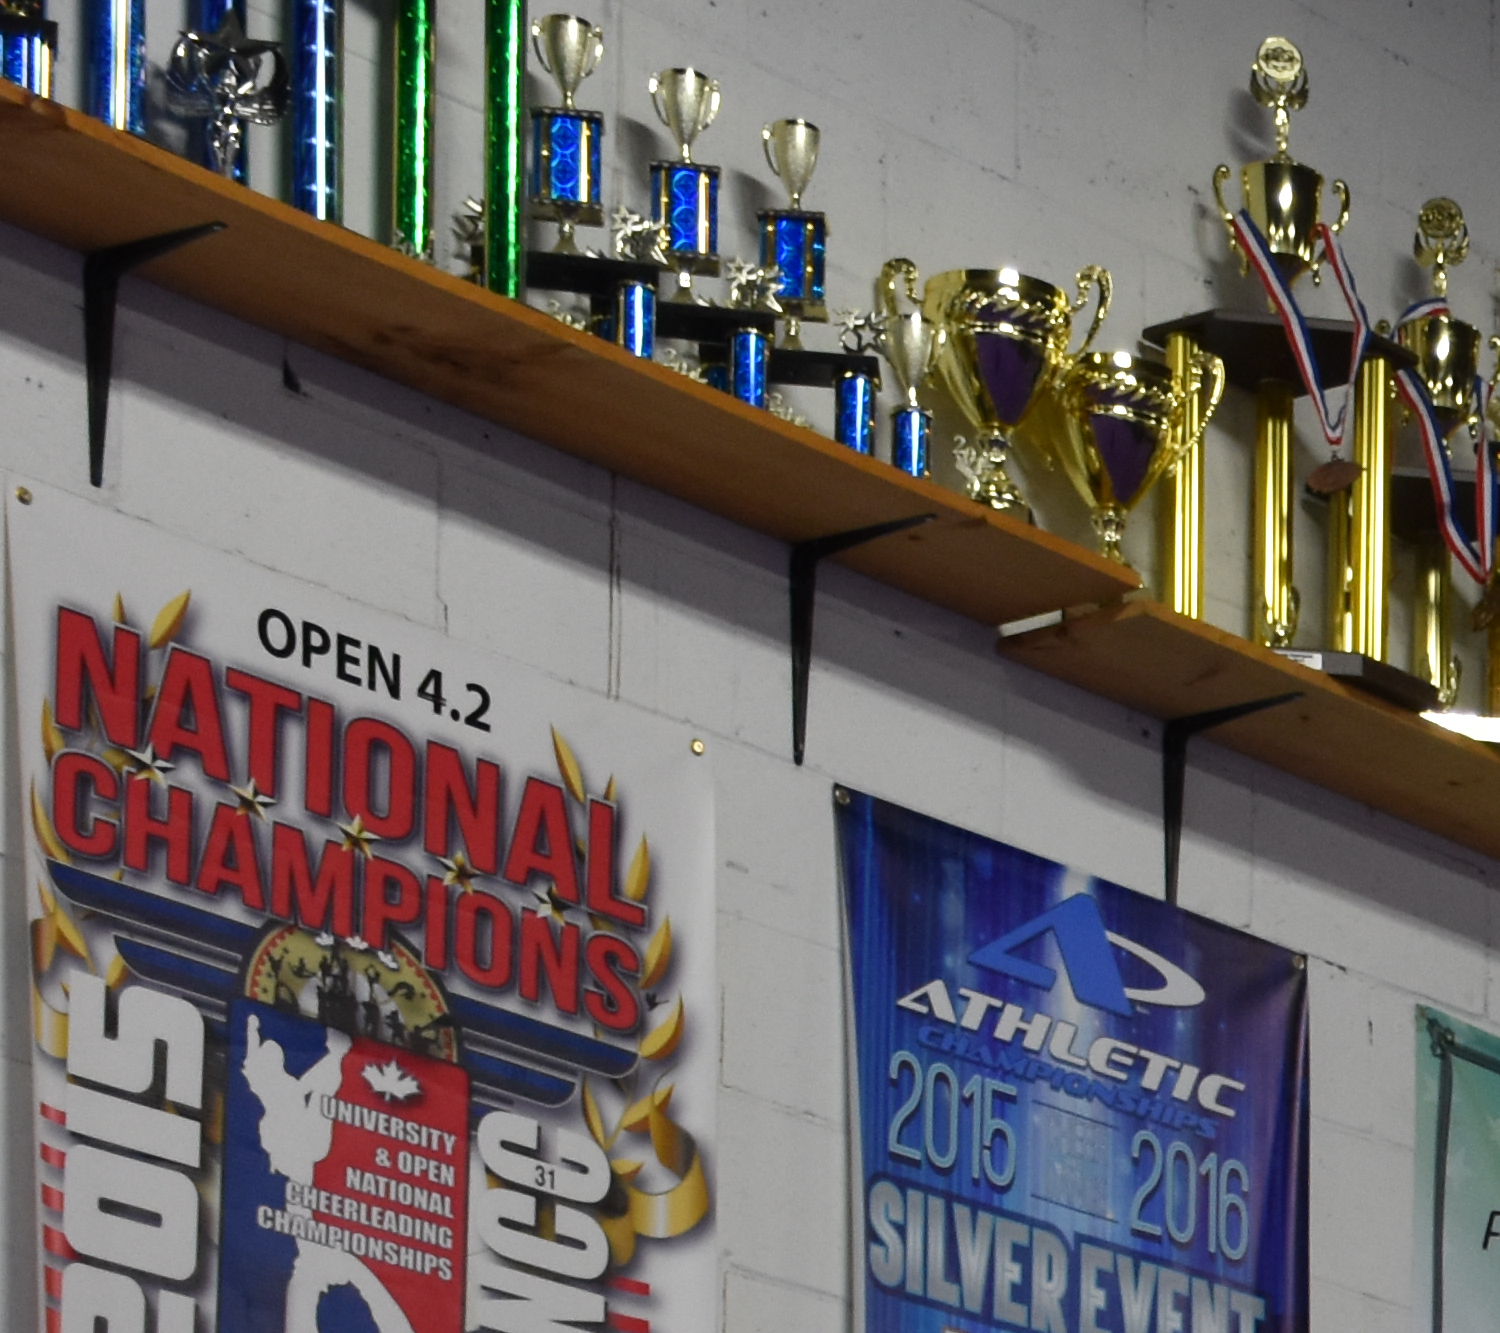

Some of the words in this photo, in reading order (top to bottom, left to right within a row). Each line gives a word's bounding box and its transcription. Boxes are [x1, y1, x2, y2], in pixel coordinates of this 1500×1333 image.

[257, 607, 402, 699] OPEN
[417, 669, 493, 732] 4.2
[54, 605, 646, 925] NATIONAL
[53, 750, 641, 1033] CHAMPIONS
[897, 977, 1246, 1118] ATHLETIC
[918, 1024, 1218, 1139] CHAMPIONSHIPS
[320, 1096, 456, 1156] UNIVERSITY
[375, 1146, 392, 1169] &
[397, 1150, 455, 1187] OPEN
[888, 1047, 1018, 1192] 2015
[1130, 1129, 1251, 1262] 2016
[257, 1205, 453, 1281] CHAMPIONSHIPS
[285, 1181, 454, 1249] CHEERLEADING
[345, 1166, 455, 1218] NATIONAL
